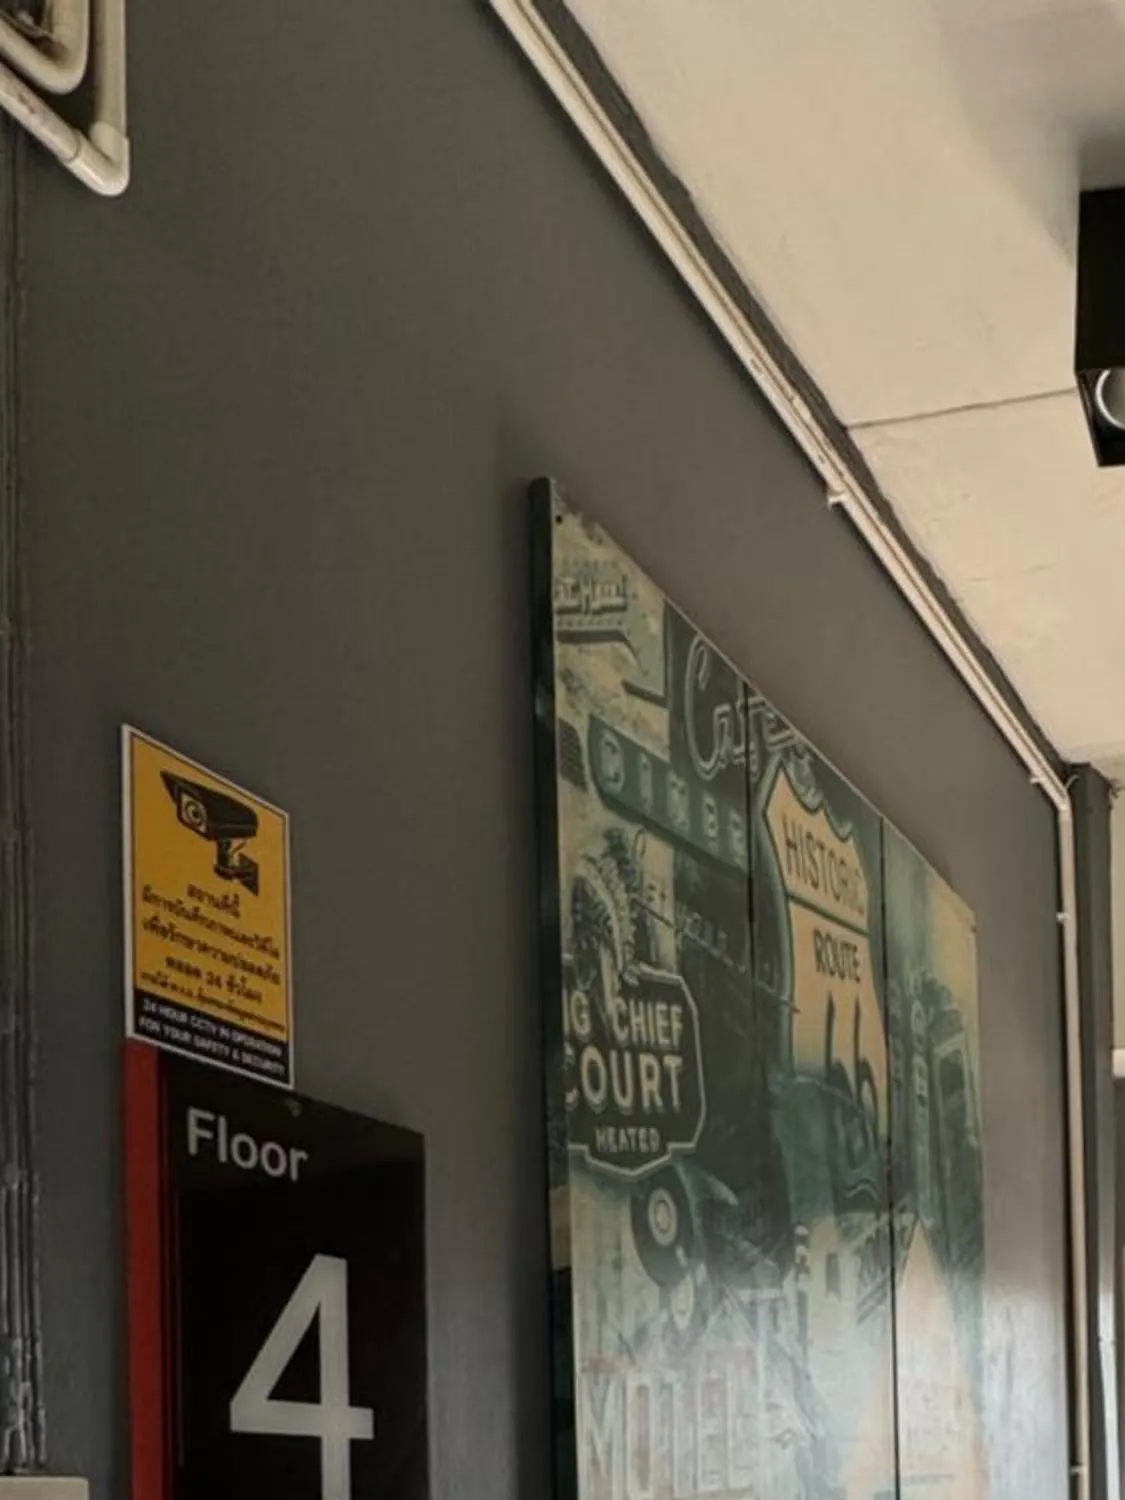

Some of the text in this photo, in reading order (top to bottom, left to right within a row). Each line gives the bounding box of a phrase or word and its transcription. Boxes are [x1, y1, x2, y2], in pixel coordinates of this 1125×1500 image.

[813, 927, 861, 984] ROUTE
[142, 998, 157, 1013] 24
[158, 1003, 189, 1024] HOUR
[189, 1014, 217, 1035] CCTV
[612, 996, 683, 1048] CHIEF
[138, 1015, 162, 1034] FOR
[163, 1023, 192, 1044] YOUR
[193, 1036, 231, 1057] SAFETY
[240, 1051, 286, 1077] SECURITY
[186, 1106, 309, 1182] Floor
[594, 1126, 661, 1154] HEATED
